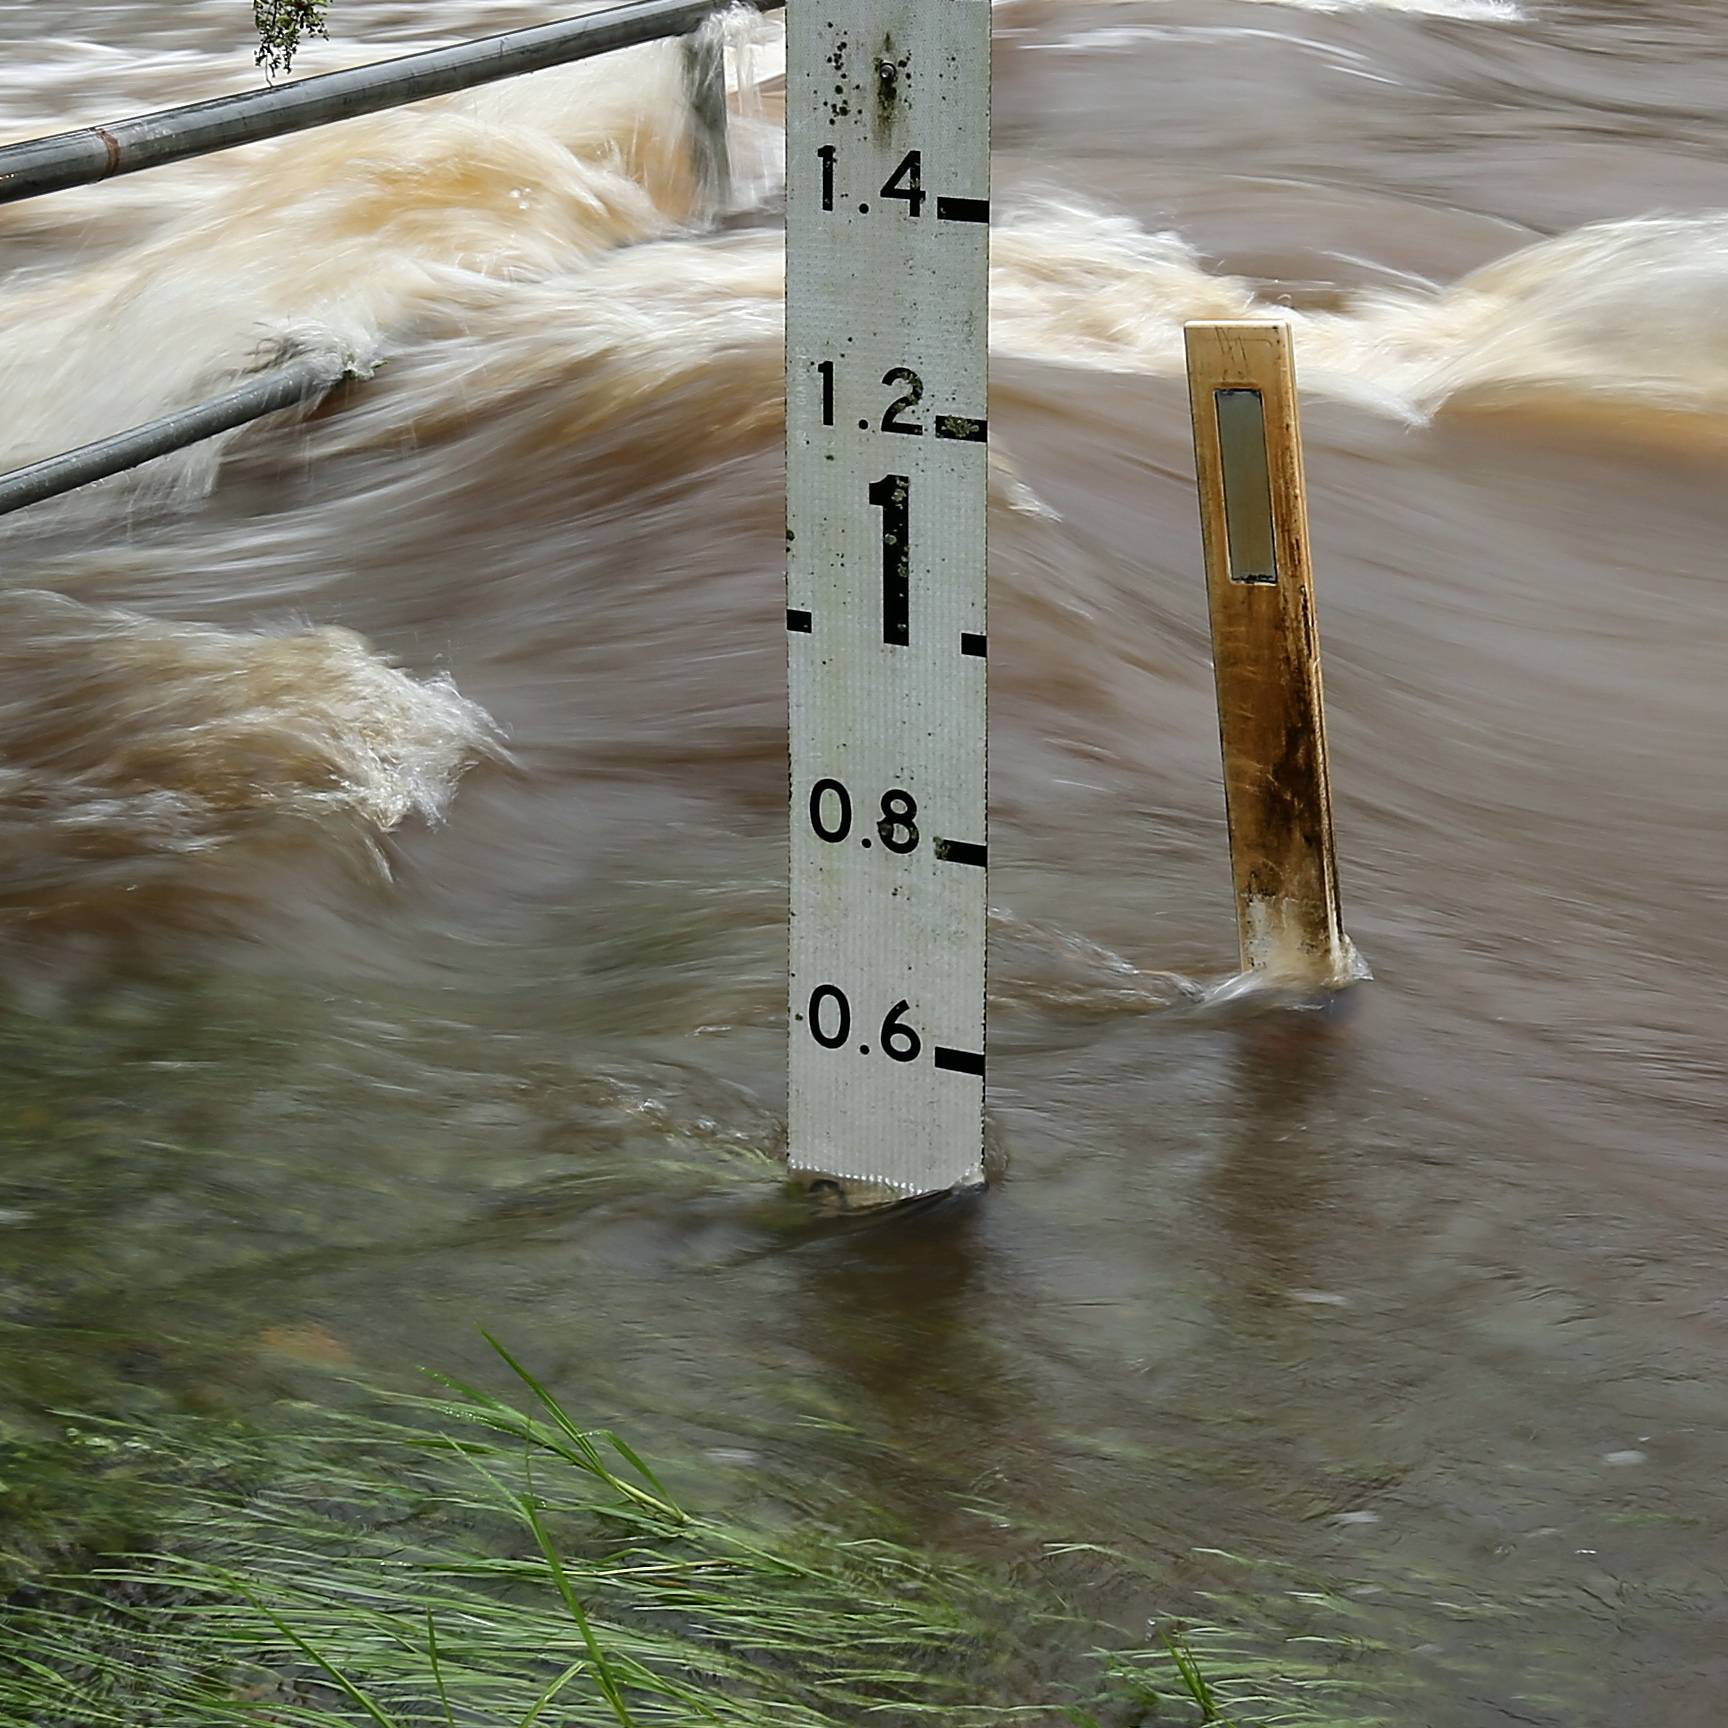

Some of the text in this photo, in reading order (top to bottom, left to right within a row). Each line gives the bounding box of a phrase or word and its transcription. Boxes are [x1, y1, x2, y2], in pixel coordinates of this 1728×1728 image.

[817, 144, 927, 218] 1.4
[817, 360, 924, 436] 1.2
[868, 474, 910, 647] 1
[809, 778, 920, 855] 0.8
[808, 984, 921, 1063] 0.6
